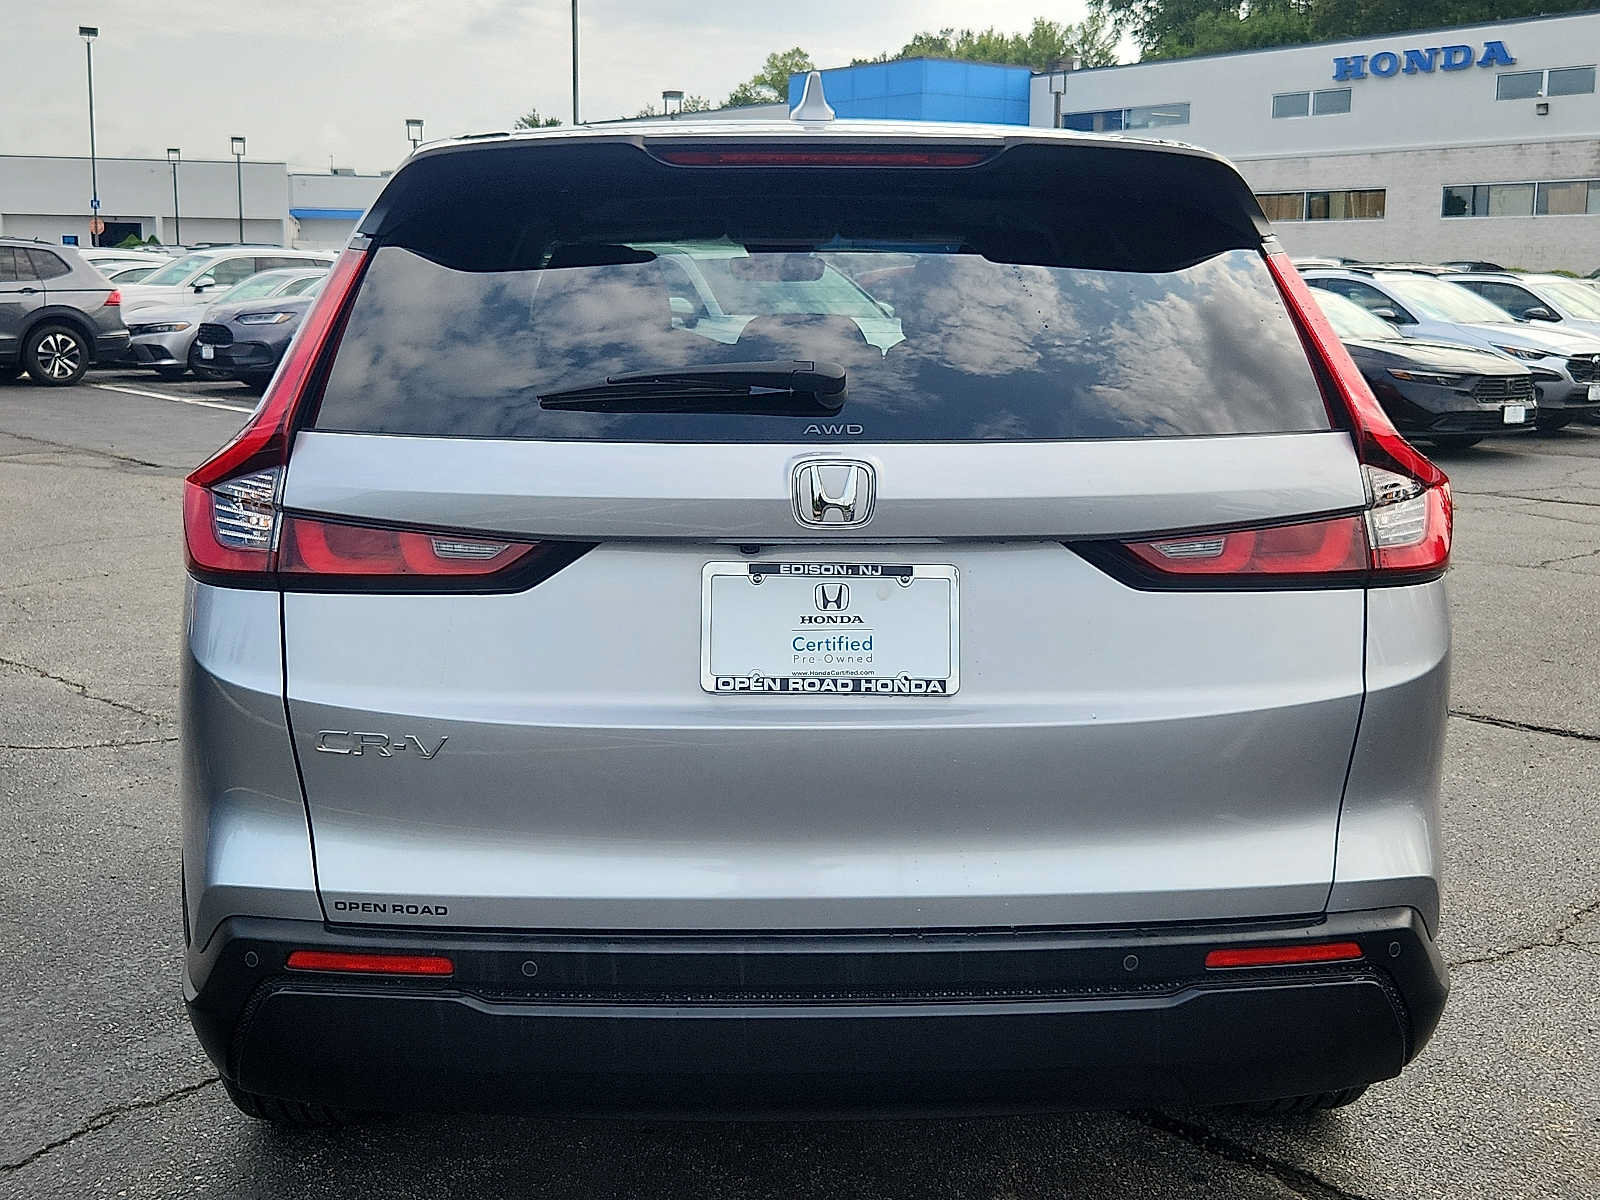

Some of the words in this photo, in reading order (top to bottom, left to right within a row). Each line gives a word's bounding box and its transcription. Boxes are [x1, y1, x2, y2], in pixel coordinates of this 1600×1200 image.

[1332, 40, 1517, 82] HONDA
[803, 424, 864, 435] AWD
[779, 564, 853, 576] EDISON,
[859, 566, 882, 575] NJ
[799, 615, 865, 624] HONDA
[792, 635, 873, 651] Certified
[717, 677, 781, 691] OPEN
[788, 679, 854, 692] ROAD
[860, 679, 944, 693] HONDA
[316, 729, 449, 760] CR-V
[334, 901, 387, 913] OPEN
[391, 904, 448, 916] ROAD
